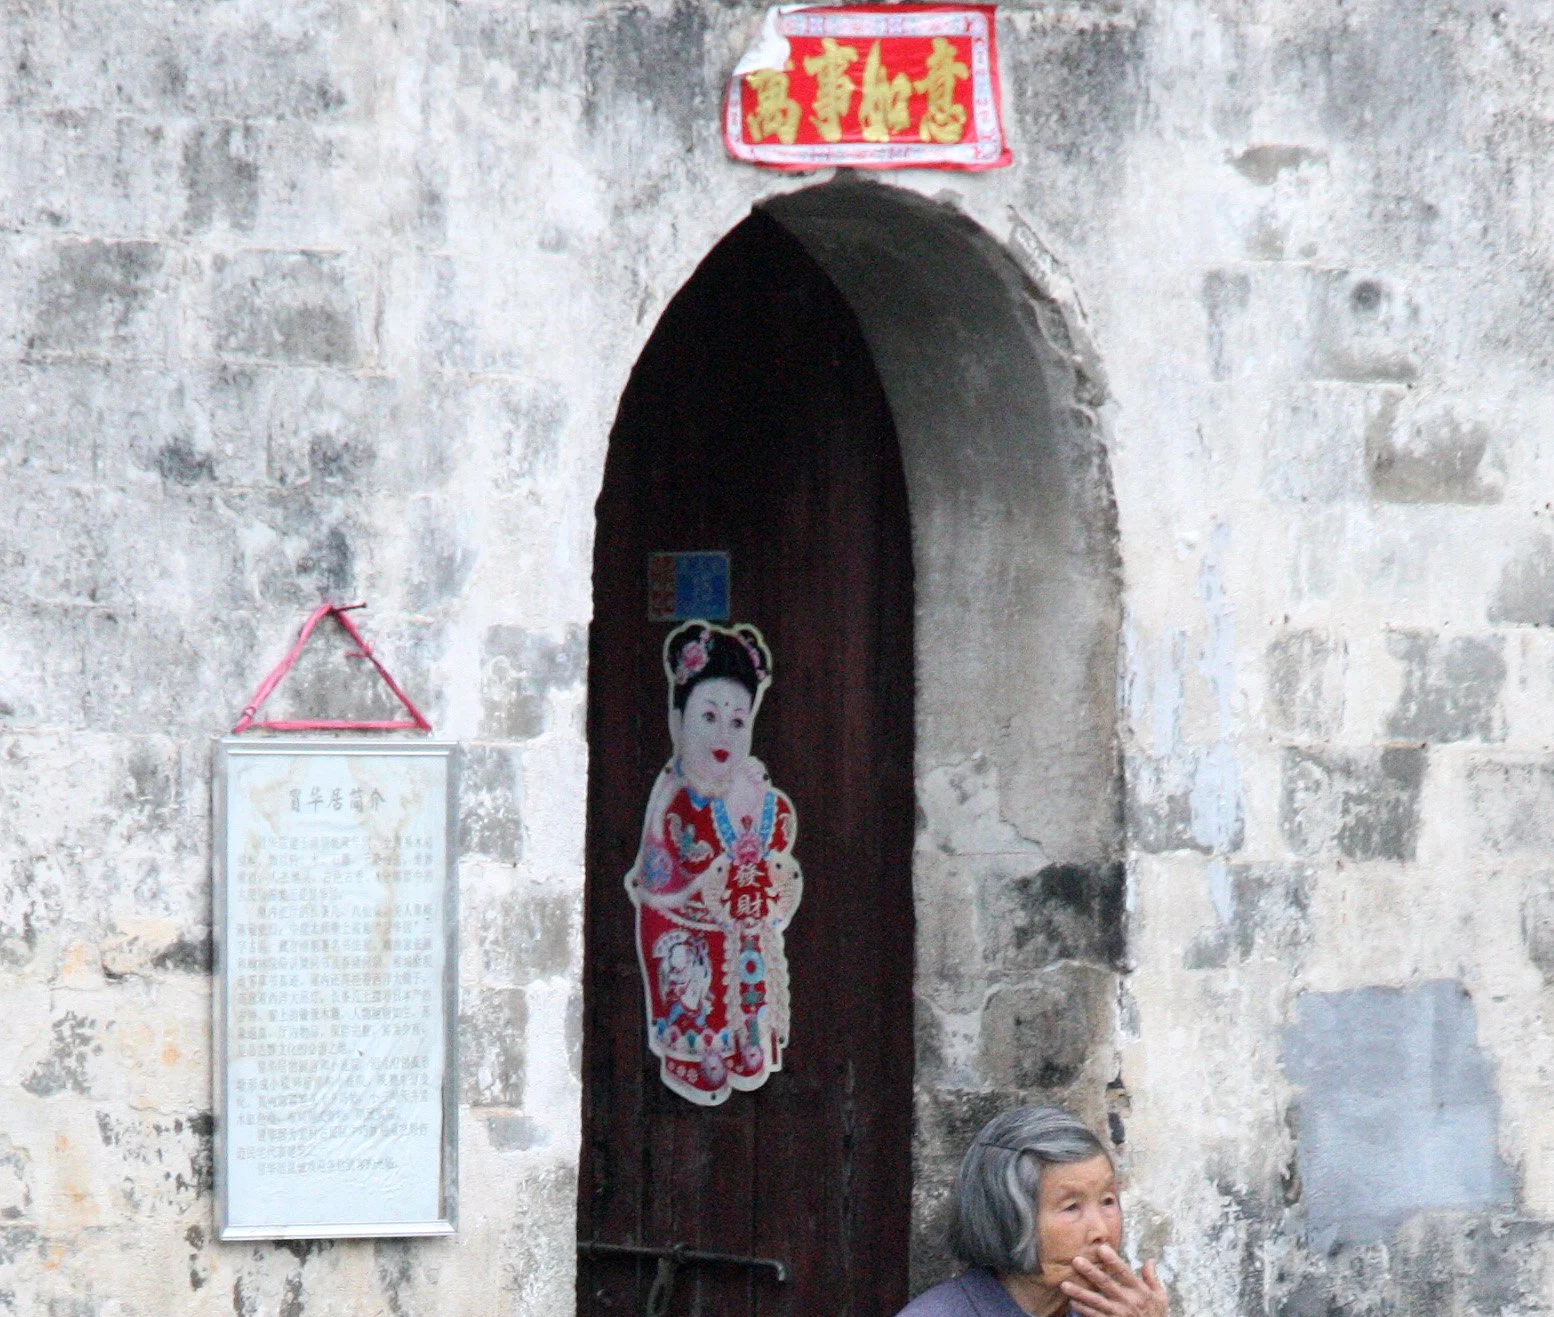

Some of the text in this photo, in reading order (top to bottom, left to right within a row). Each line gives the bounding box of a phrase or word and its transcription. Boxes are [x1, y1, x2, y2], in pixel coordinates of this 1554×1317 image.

[746, 37, 969, 144] 萬事如意
[733, 862, 766, 918] 發財
